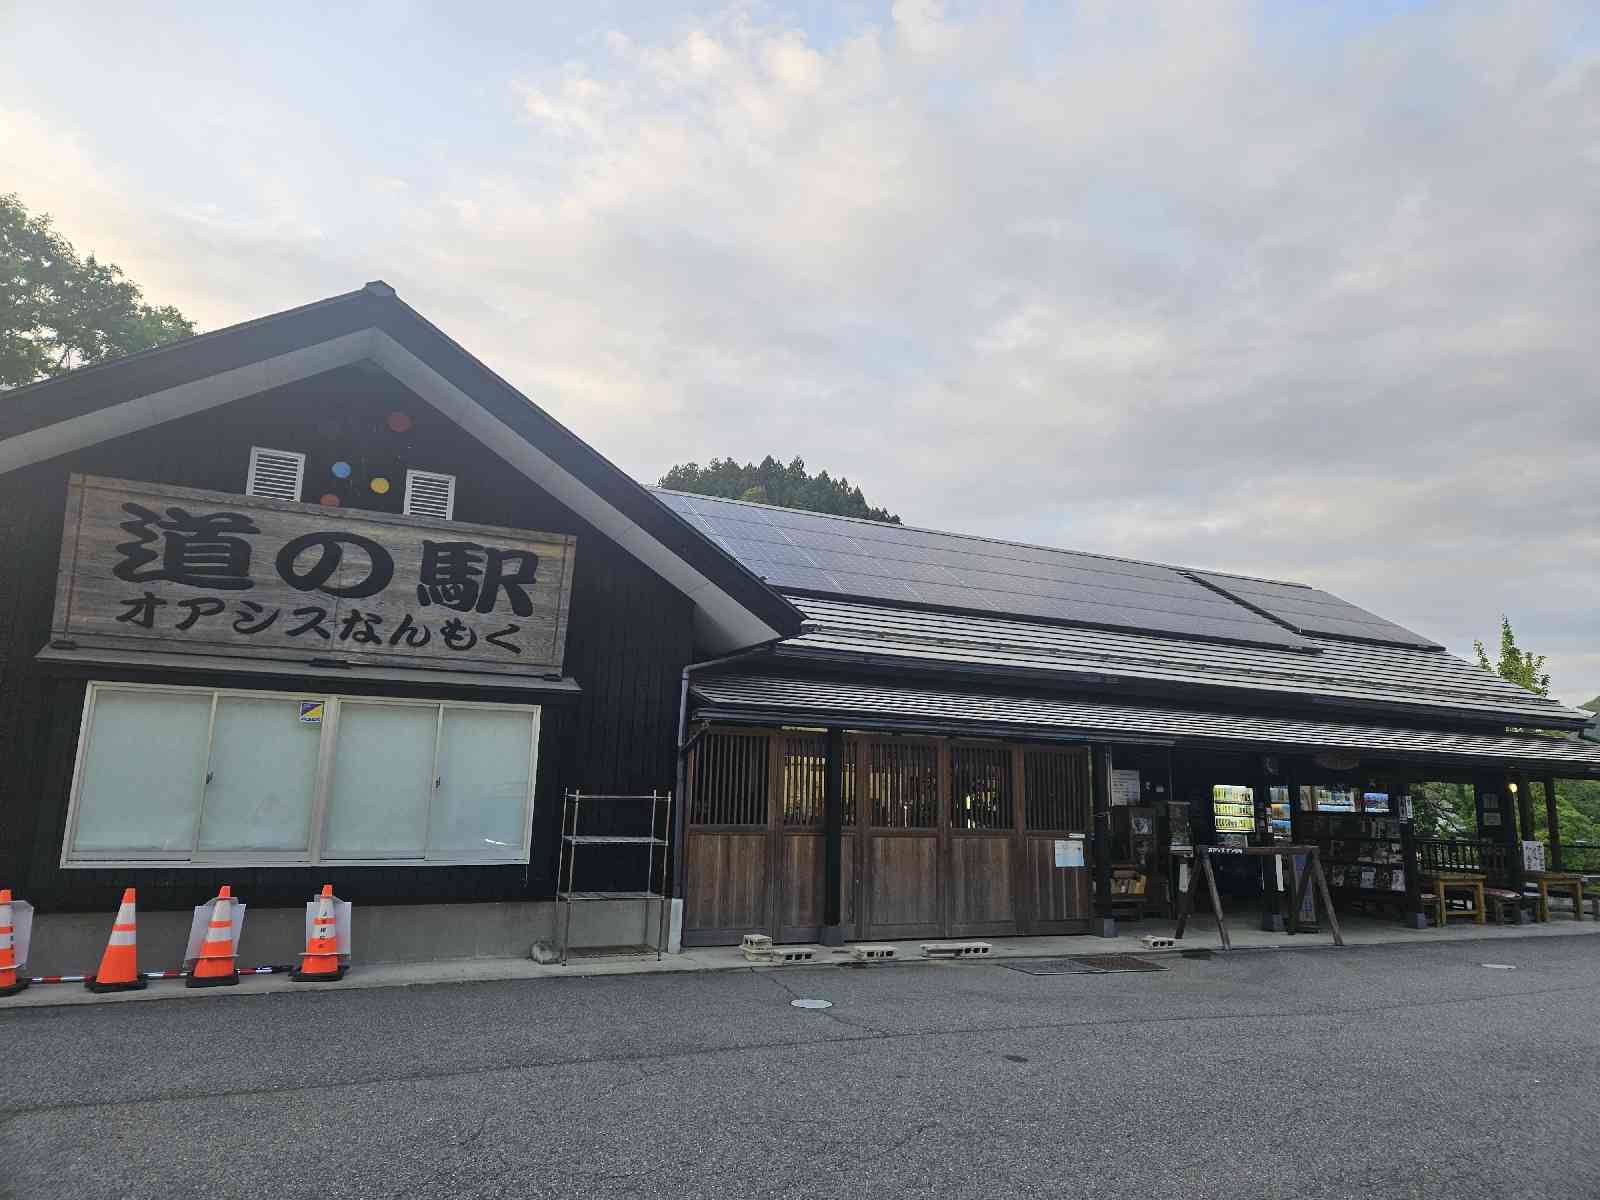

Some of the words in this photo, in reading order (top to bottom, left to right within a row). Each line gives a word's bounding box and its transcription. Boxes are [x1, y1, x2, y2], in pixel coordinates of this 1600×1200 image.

[112, 502, 539, 617] 道の駅
[116, 591, 522, 654] オアシスなんもく
